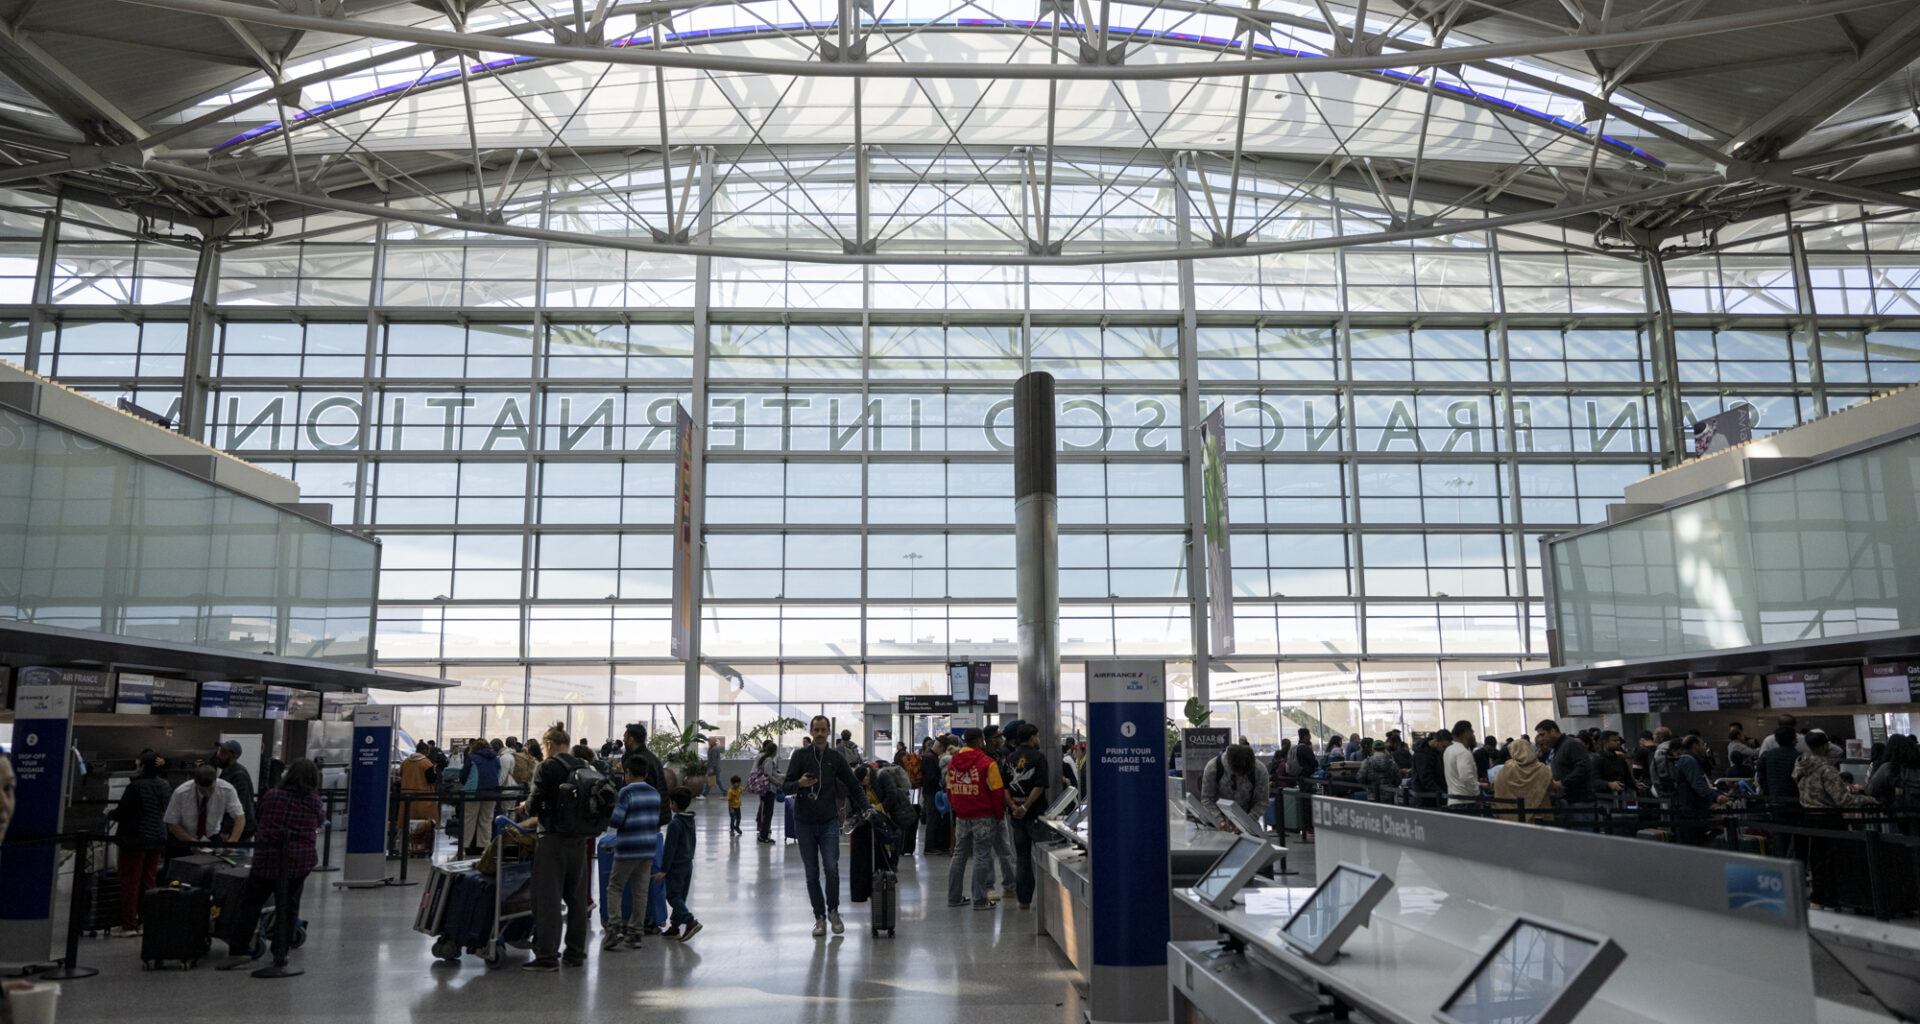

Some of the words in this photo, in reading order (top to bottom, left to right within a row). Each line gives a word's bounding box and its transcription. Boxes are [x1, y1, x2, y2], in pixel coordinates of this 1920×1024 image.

[62, 673, 73, 682] AIR
[74, 673, 99, 684] FRANCE
[1189, 735, 1216, 744] QATAR
[1101, 756, 1140, 764] BAGGAGE
[1119, 765, 1140, 773] HERE
[1333, 806, 1348, 826] Self
[1350, 808, 1381, 834] Service
[1382, 814, 1425, 841] Check-in
[1757, 874, 1782, 892] SFO
